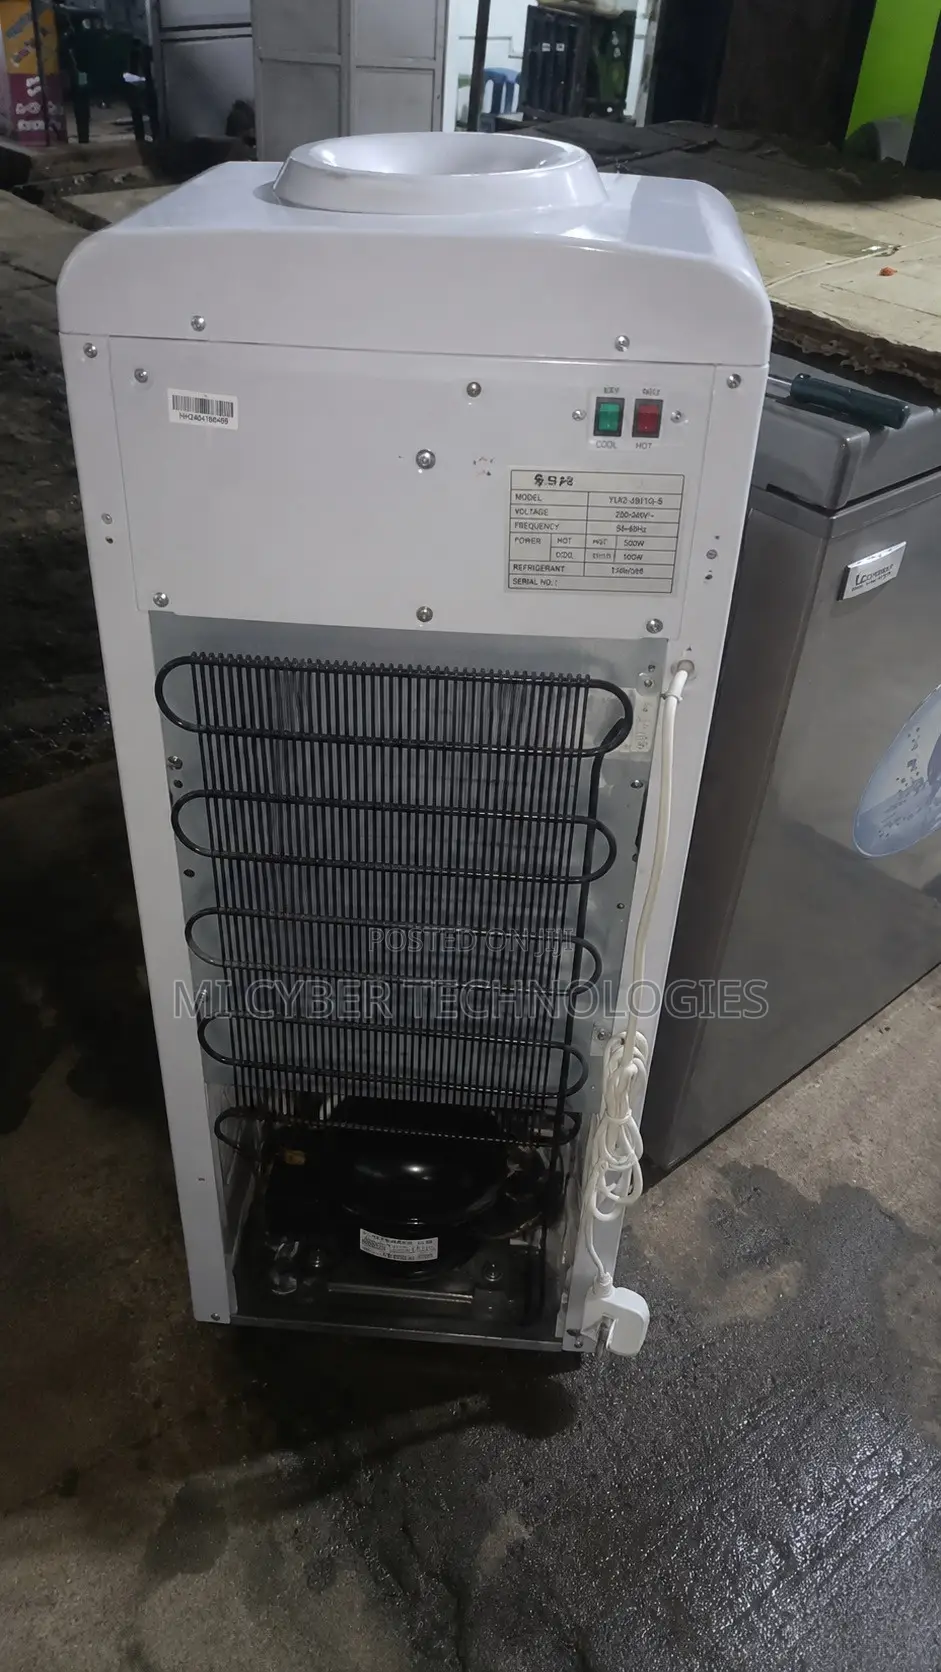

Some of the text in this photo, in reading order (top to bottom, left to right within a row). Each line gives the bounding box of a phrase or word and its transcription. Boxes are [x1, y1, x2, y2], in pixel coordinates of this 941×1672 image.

[515, 493, 543, 502] MODEL
[514, 507, 549, 517] VOLTAGE
[514, 522, 560, 531] FREQUENCY
[513, 564, 565, 573] REFRIGERANT
[513, 578, 538, 586] SERIAL
